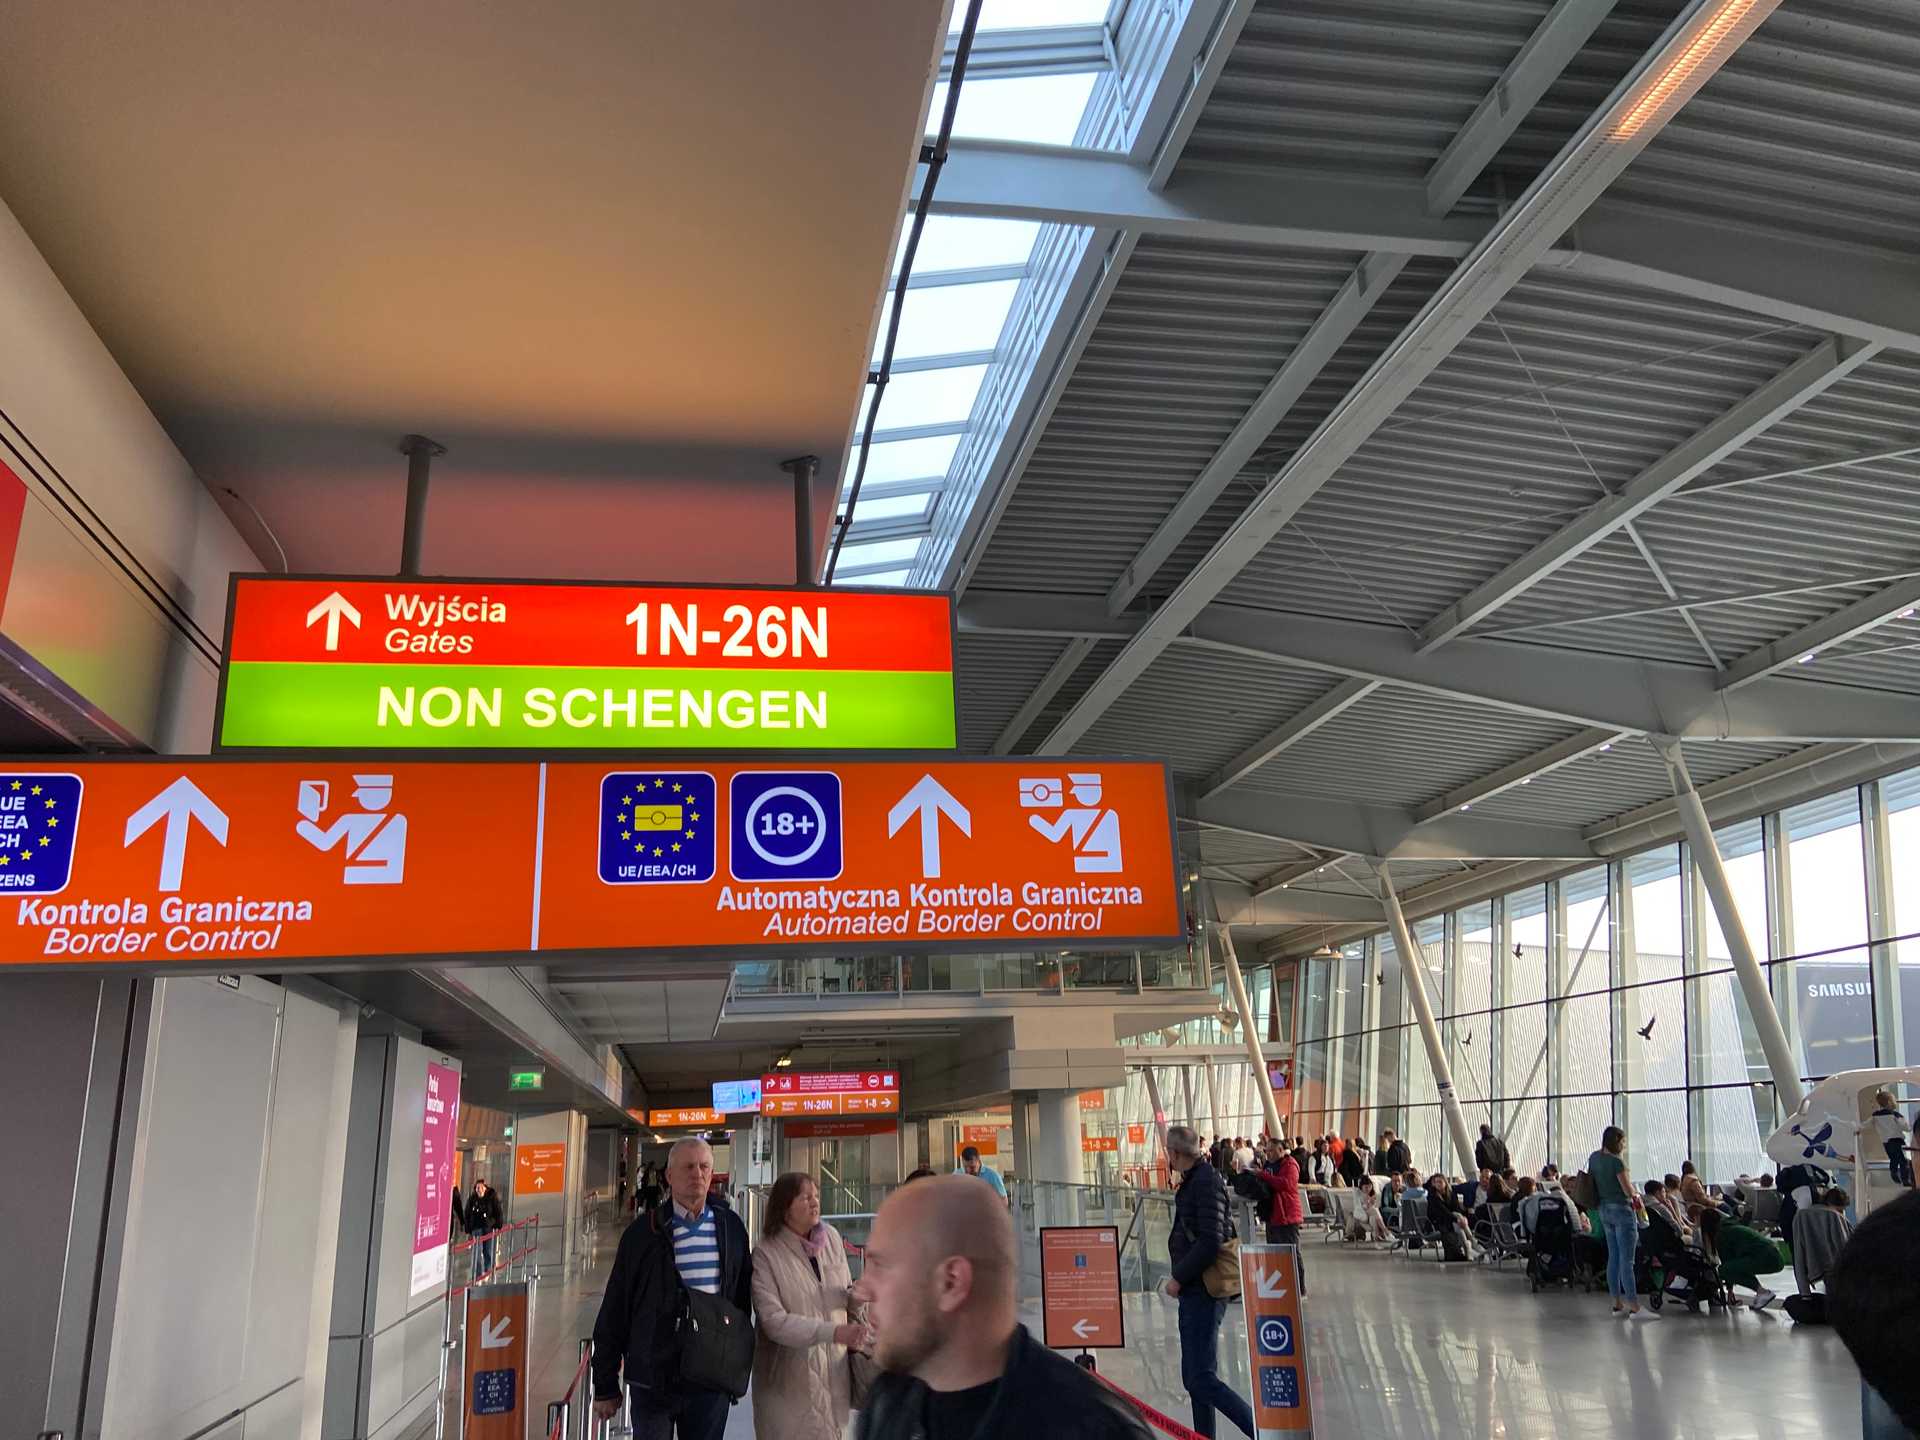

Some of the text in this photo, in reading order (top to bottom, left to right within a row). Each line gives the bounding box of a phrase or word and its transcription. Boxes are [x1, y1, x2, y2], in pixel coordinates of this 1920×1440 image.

[385, 594, 506, 624] Wyjścia
[385, 628, 474, 654] Gates
[625, 602, 829, 658] 1N-26N
[377, 687, 828, 729] NON SCHENGEN
[0, 815, 29, 830] EA
[761, 812, 815, 837] 18+
[618, 863, 697, 878] UE/EEA/CH
[17, 895, 313, 926] Kontrola Graniczna
[716, 881, 1143, 913] Automatyczna Kontrola Graniczna
[763, 906, 1103, 937] Automated Border Control
[43, 923, 282, 954] Border Control
[1265, 1330, 1284, 1340] 18+
